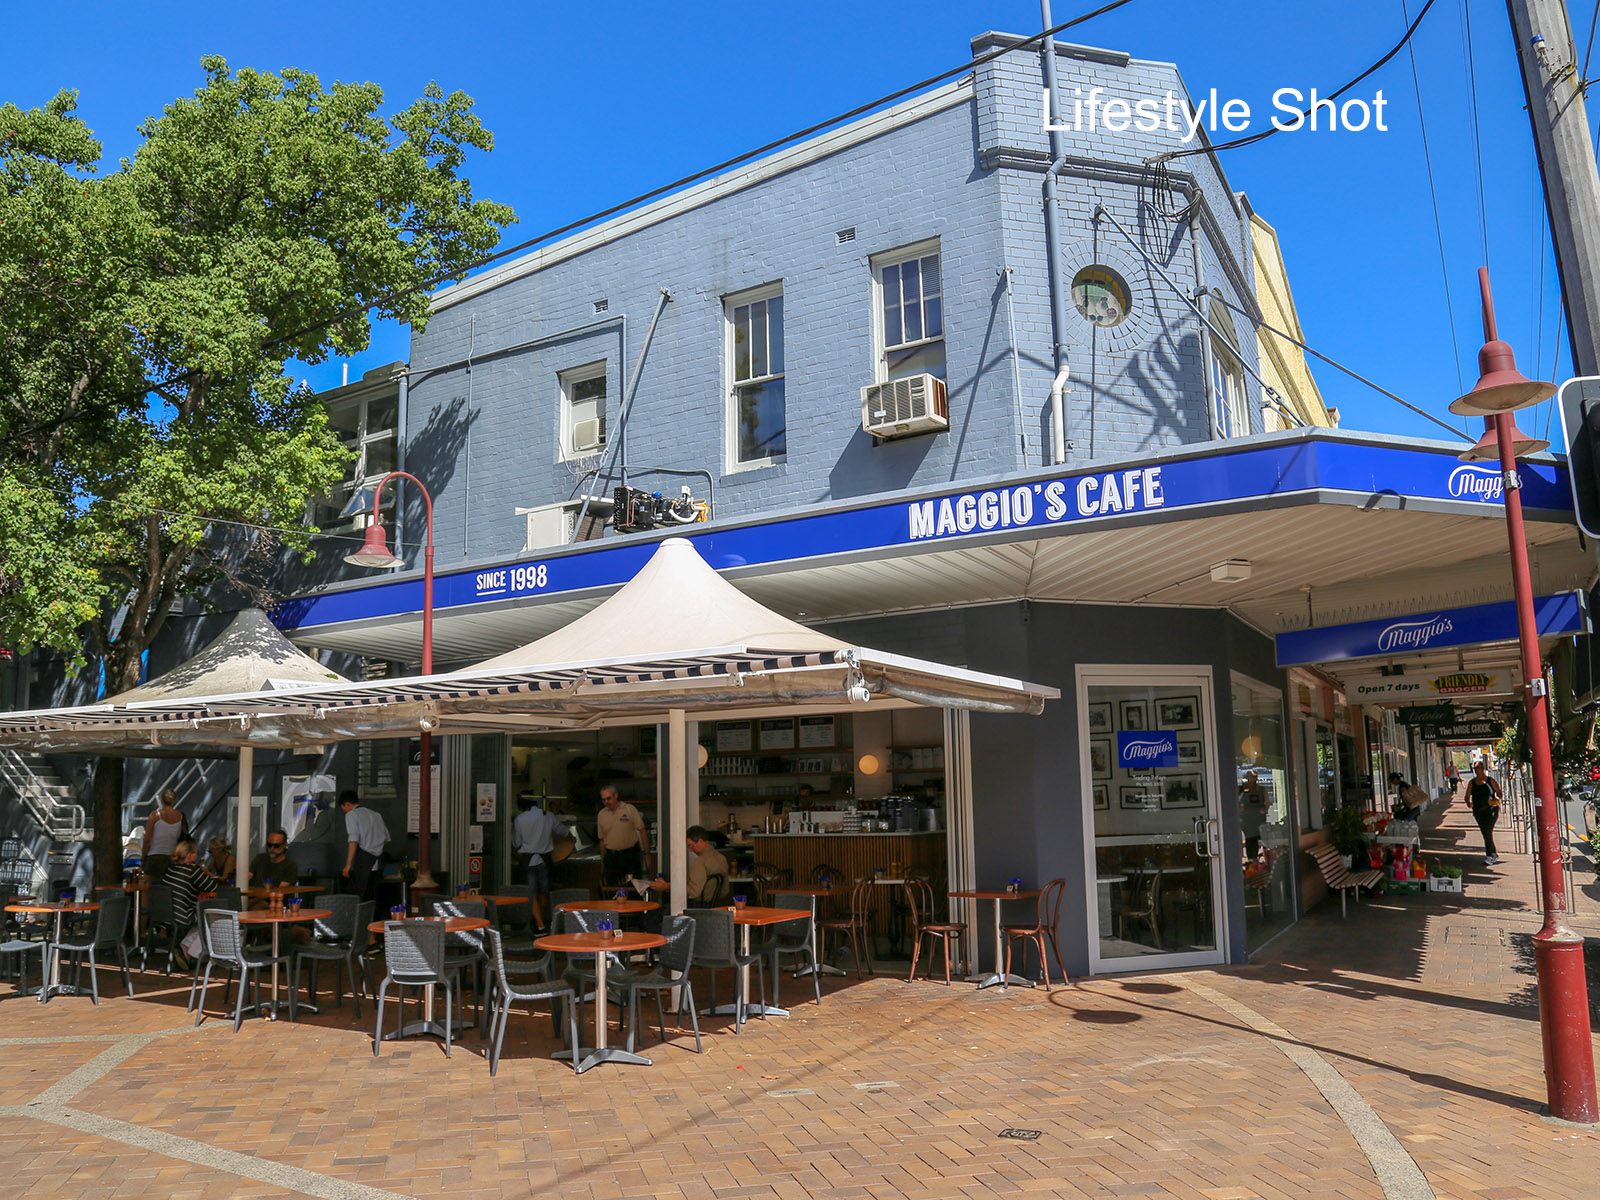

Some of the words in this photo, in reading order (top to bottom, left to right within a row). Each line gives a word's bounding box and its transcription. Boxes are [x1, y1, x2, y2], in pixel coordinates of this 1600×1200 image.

[908, 481, 1067, 540] MAGGIO'S
[1076, 466, 1164, 516] CAFE
[476, 570, 506, 590] SINCE
[510, 564, 547, 591] 1998
[1378, 614, 1453, 651] Maggio's
[1357, 685, 1385, 694] Open
[1387, 684, 1393, 692] 7
[1394, 683, 1420, 691] days
[1438, 673, 1487, 688] FRIENDLY
[1439, 685, 1486, 693] GROCER
[1440, 727, 1453, 735] The
[1123, 738, 1173, 760] Maggio's
